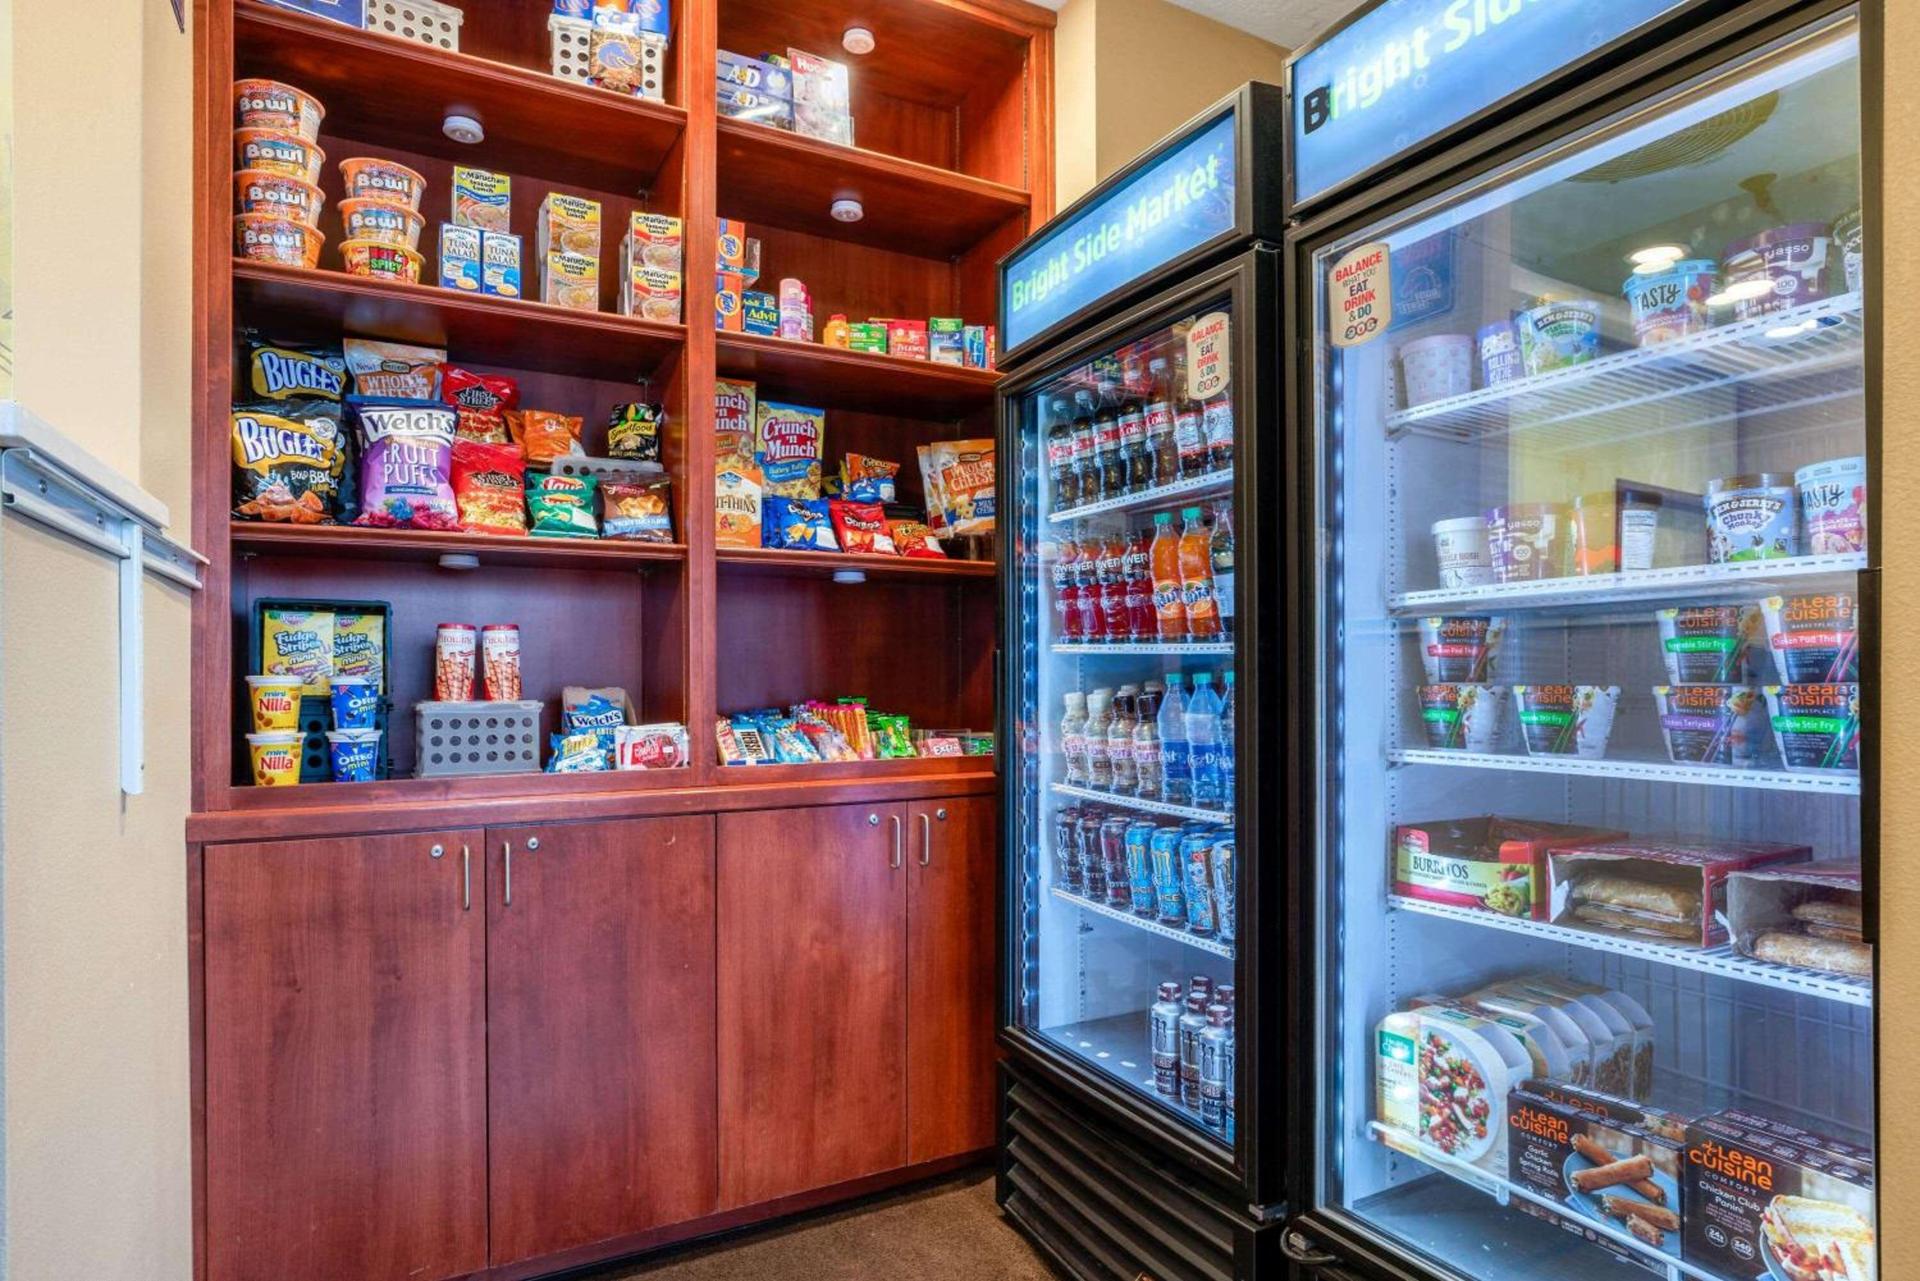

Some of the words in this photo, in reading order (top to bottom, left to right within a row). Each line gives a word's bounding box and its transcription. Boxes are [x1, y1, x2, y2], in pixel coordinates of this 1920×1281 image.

[1303, 25, 1432, 135] Bright
[1443, 0, 1540, 52] Sid
[466, 171, 506, 185] Maruchan
[560, 198, 596, 211] Maruchan
[643, 216, 678, 227] Maruchan
[1011, 250, 1069, 311] Bright
[1074, 222, 1121, 273] Side
[1125, 153, 1219, 241] Market
[446, 246, 476, 258] SALAD
[449, 238, 474, 250] TUNA
[489, 246, 515, 257] TUNA
[1764, 244, 1810, 260] yasso
[371, 259, 402, 272] SPICY
[487, 253, 516, 265] SALAD
[559, 255, 595, 267] Maruchan
[1335, 251, 1383, 282] BALANCE
[643, 270, 678, 281] Maruchan
[1349, 279, 1369, 297] EAT
[1776, 280, 1796, 289] 100
[1344, 289, 1376, 312] DRINK
[1634, 282, 1682, 311] TASTY
[748, 308, 777, 322] Advil
[1349, 310, 1357, 322] &
[1357, 304, 1372, 319] DO
[1191, 320, 1225, 342] BALANCE
[1200, 343, 1214, 356] EAT
[1197, 352, 1219, 369] DRINK
[260, 352, 341, 395] BUGLES
[365, 412, 454, 434] Welch's
[762, 418, 816, 441] Crunch
[611, 424, 652, 440] Smartfood
[383, 443, 439, 467] FRUIT
[766, 440, 816, 462] Munch
[383, 463, 439, 487] PUFFS
[1802, 483, 1846, 511] TASTY
[844, 516, 881, 529] Doritos
[1802, 595, 1852, 608] Lean
[1783, 607, 1851, 621] cuisine
[275, 630, 317, 645] Fudge
[263, 689, 287, 697] mini
[1798, 683, 1848, 695] Lean
[259, 697, 291, 712] Nilla
[576, 710, 621, 726] Welch's
[1801, 720, 1818, 729] Stir
[1820, 720, 1834, 732] Fry
[265, 748, 288, 756] mini
[260, 756, 294, 771] Nilla
[1510, 1114, 1569, 1144] Cuisine
[1529, 1109, 1568, 1133] Lean
[1520, 1131, 1558, 1150] COMFORT
[1524, 1151, 1553, 1168] Chicken
[1718, 1146, 1772, 1177] Lean
[1689, 1149, 1773, 1191] Cuisine
[1704, 1170, 1757, 1196] COMFORT
[1699, 1180, 1737, 1201] Chicken
[1738, 1196, 1761, 1212] Club
[1714, 1196, 1745, 1214] Panini
